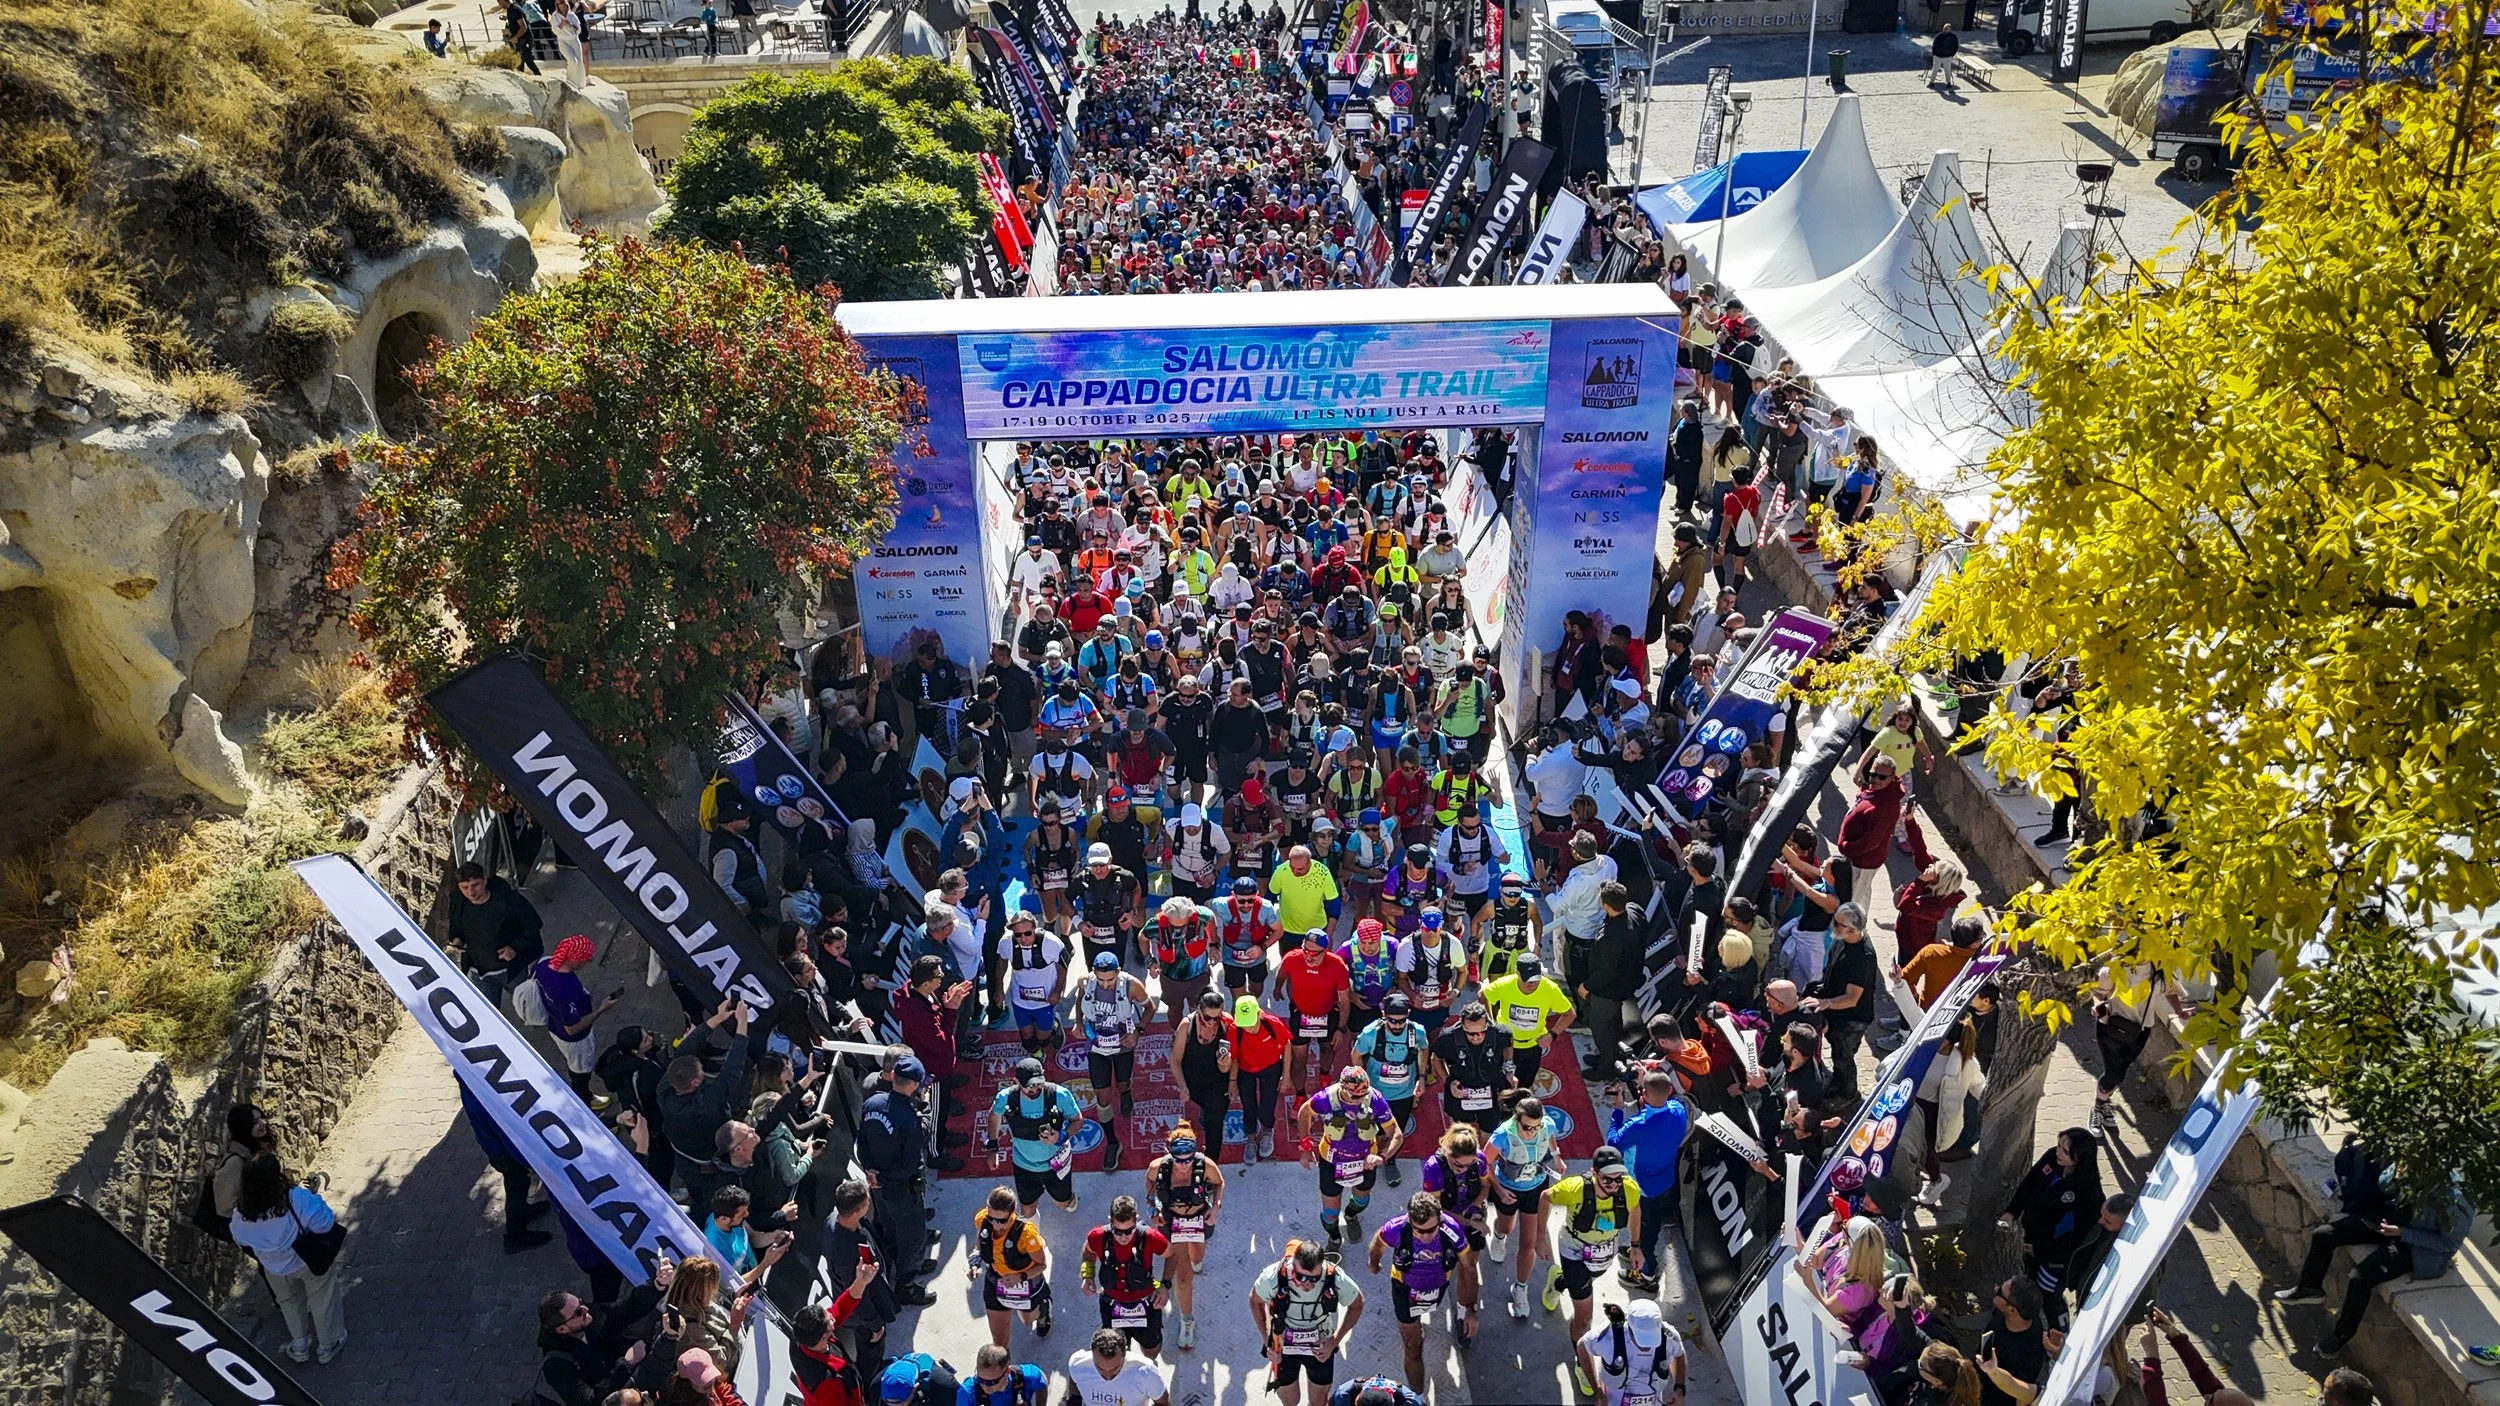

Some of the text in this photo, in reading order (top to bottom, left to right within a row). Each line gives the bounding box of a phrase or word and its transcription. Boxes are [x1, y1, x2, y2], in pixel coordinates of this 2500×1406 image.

[1680, 13, 1720, 27] RGÜP
[1396, 117, 1408, 132] P
[1162, 341, 1356, 374] SALOMON
[1001, 369, 1502, 408] CAPPADOCIA ULTRA TRAIL
[1586, 385, 1635, 398] CAPPADOCIA
[1002, 402, 1503, 429] 17-19 OCTOBER 2025 IT IS NOT JUST A RACE
[1561, 431, 1649, 443] SALOMON
[1571, 489, 1626, 499] GARMIN
[875, 546, 958, 558] SALOMON
[923, 569, 967, 577] GARMIN
[465, 802, 496, 862] SAL
[1693, 933, 1702, 975] SALOMO
[1756, 1301, 1824, 1406] SAL
[1091, 1391, 1123, 1404] HIGH
